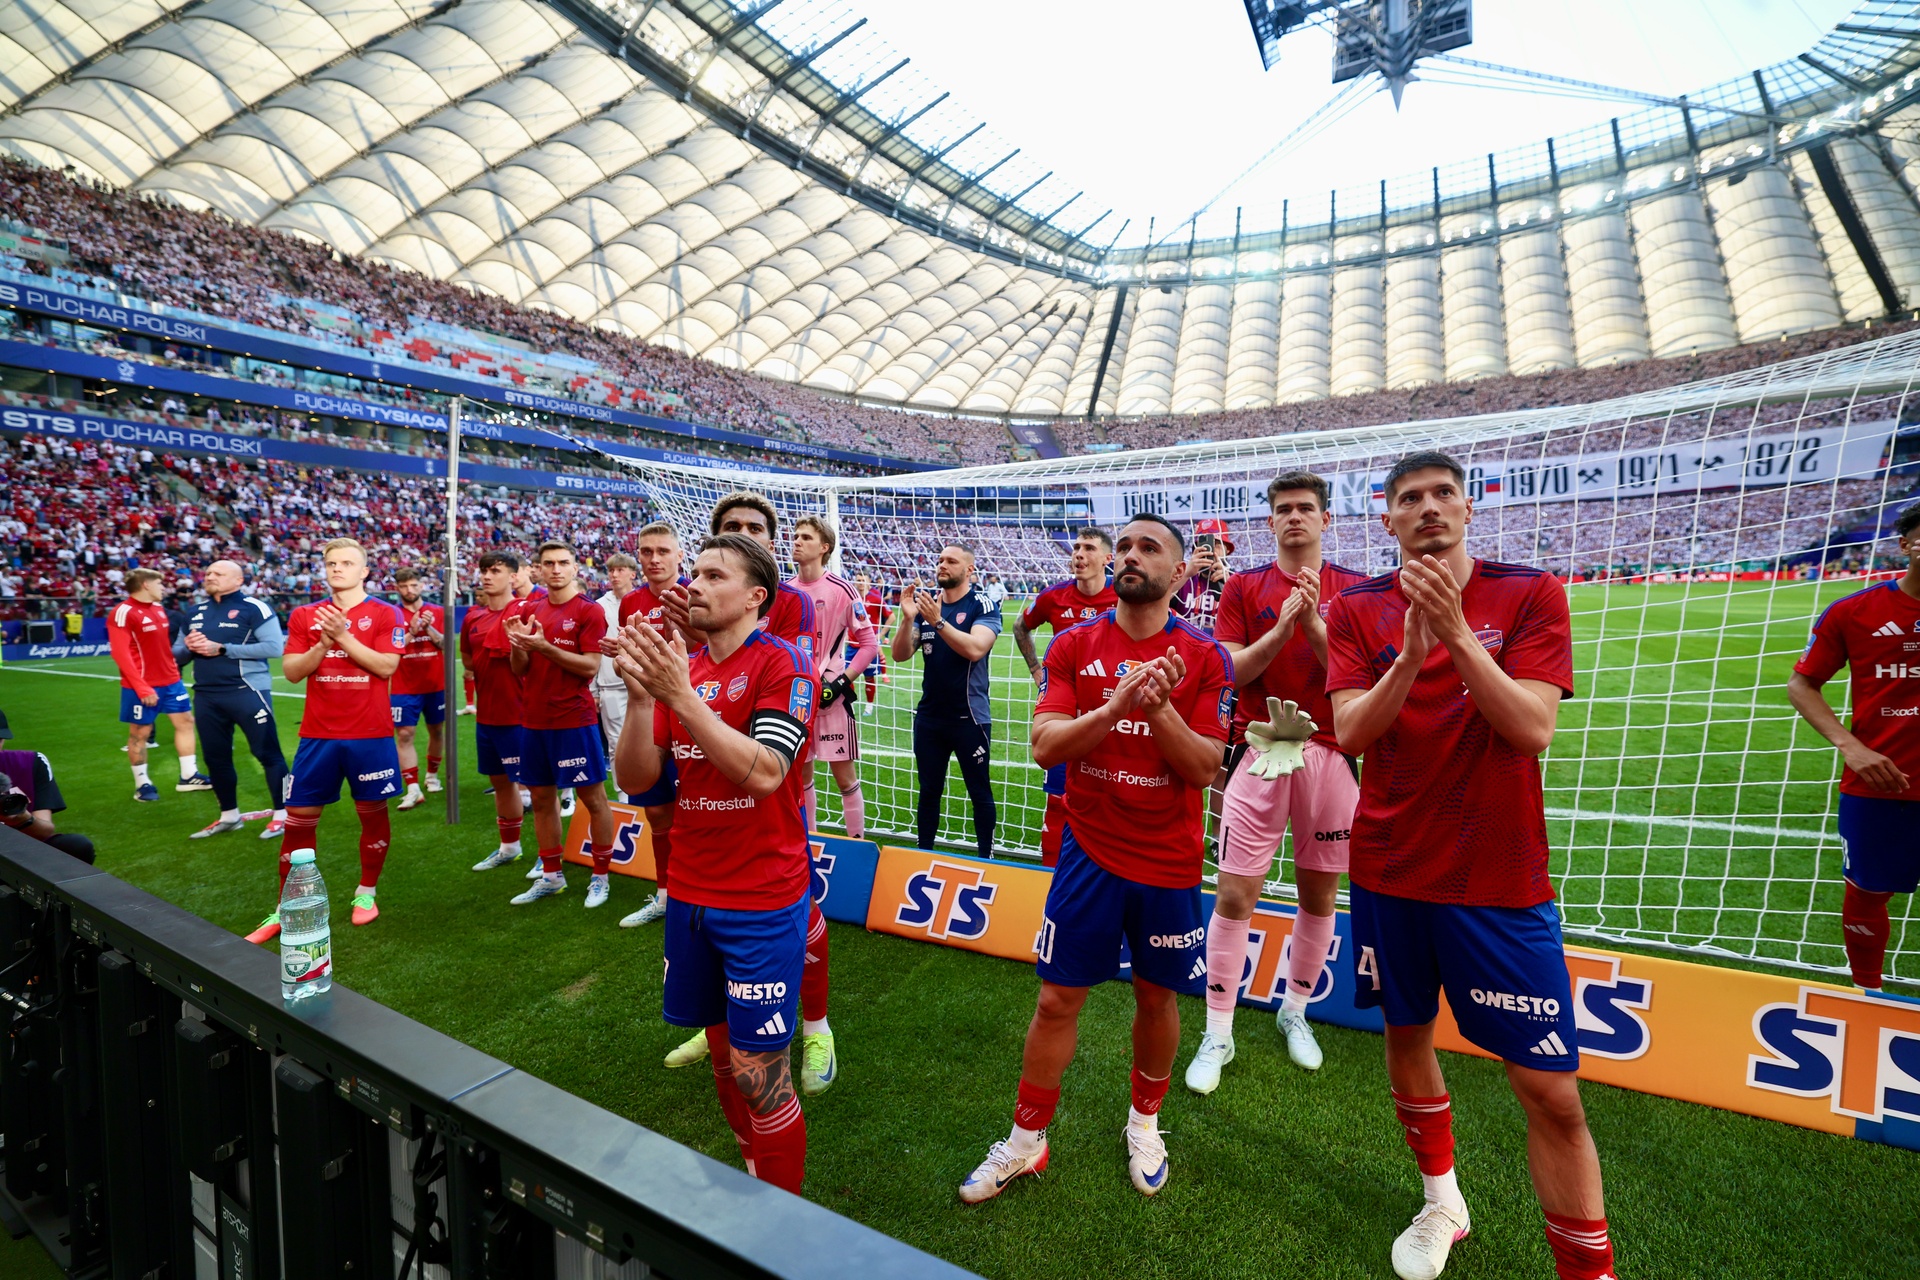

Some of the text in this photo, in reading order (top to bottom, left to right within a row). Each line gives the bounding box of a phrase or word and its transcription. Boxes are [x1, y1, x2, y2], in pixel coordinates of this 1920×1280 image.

[26, 290, 129, 325] PUCHAR
[133, 313, 206, 342] POLSKI
[294, 393, 502, 438] PUCHAR TYSIĄCA RUŻYN
[505, 390, 612, 420] STS PUCHAR POLSKI
[2, 410, 263, 455] STS PUCHAR POLSKI
[764, 439, 829, 457] STS PUCHAR POLSKI
[1740, 437, 1822, 478] 1972
[663, 452, 697, 465] PUCHAR
[698, 458, 741, 472] TYSIĄCA
[1617, 452, 1680, 489] 1971
[555, 476, 584, 489] STS
[585, 478, 626, 494] PUCHAR
[1508, 462, 1569, 498] 1970
[1122, 490, 1169, 517] 1965
[1202, 485, 1250, 513] 1968
[1080, 607, 1097, 620] STS
[1115, 660, 1143, 678] ST
[695, 681, 721, 701] STS
[133, 705, 143, 720] 9
[358, 768, 395, 782] ONESTO
[895, 860, 998, 940] STS
[1149, 927, 1205, 949] ONESTO
[1358, 945, 1381, 991] 4
[727, 981, 787, 1000] ONESTO
[1470, 988, 1560, 1016] ONESTO
[1528, 1015, 1560, 1023] ENERGY
